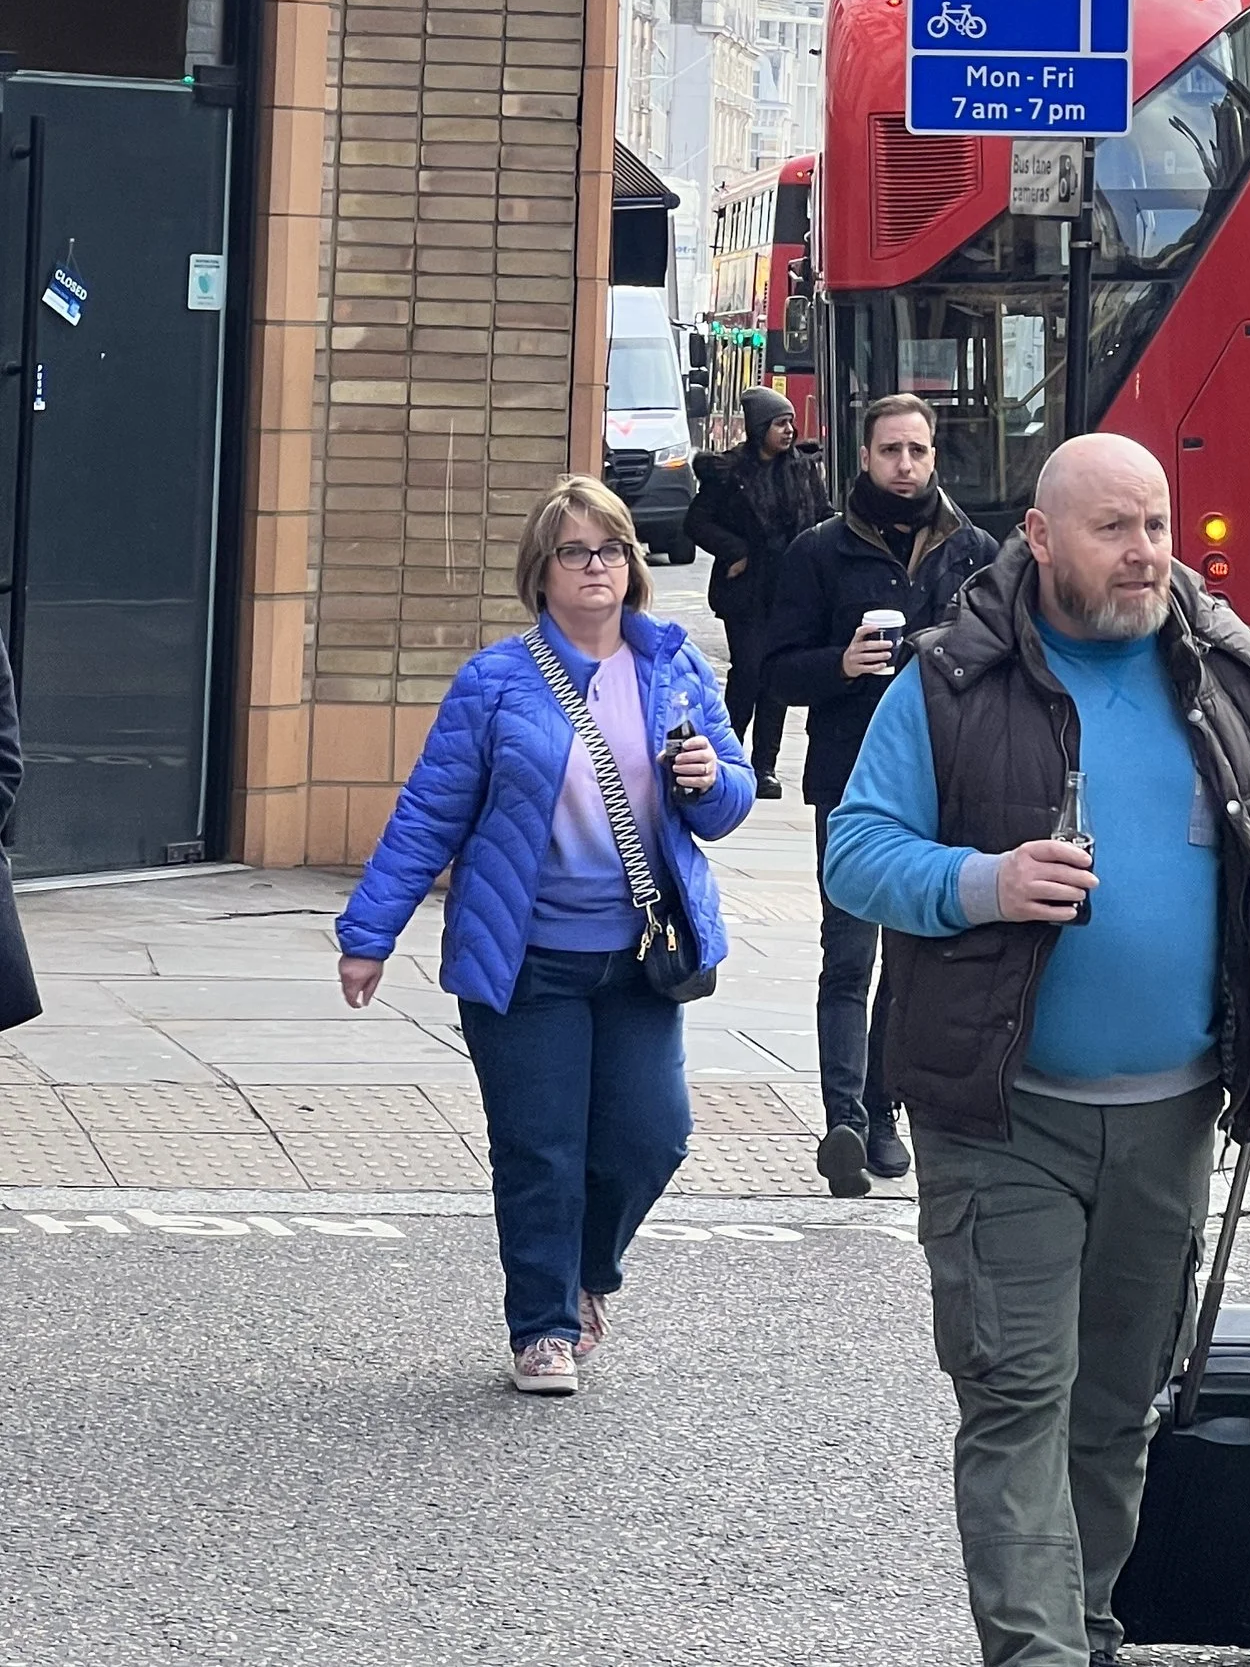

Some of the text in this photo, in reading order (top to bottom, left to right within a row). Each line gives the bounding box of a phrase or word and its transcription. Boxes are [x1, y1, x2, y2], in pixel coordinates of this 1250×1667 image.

[966, 65, 1020, 87] Mon
[1042, 66, 1075, 88] Fri
[1013, 154, 1052, 175] Bus lane
[1012, 187, 1050, 202] cameras
[54, 269, 88, 301] CLOSED
